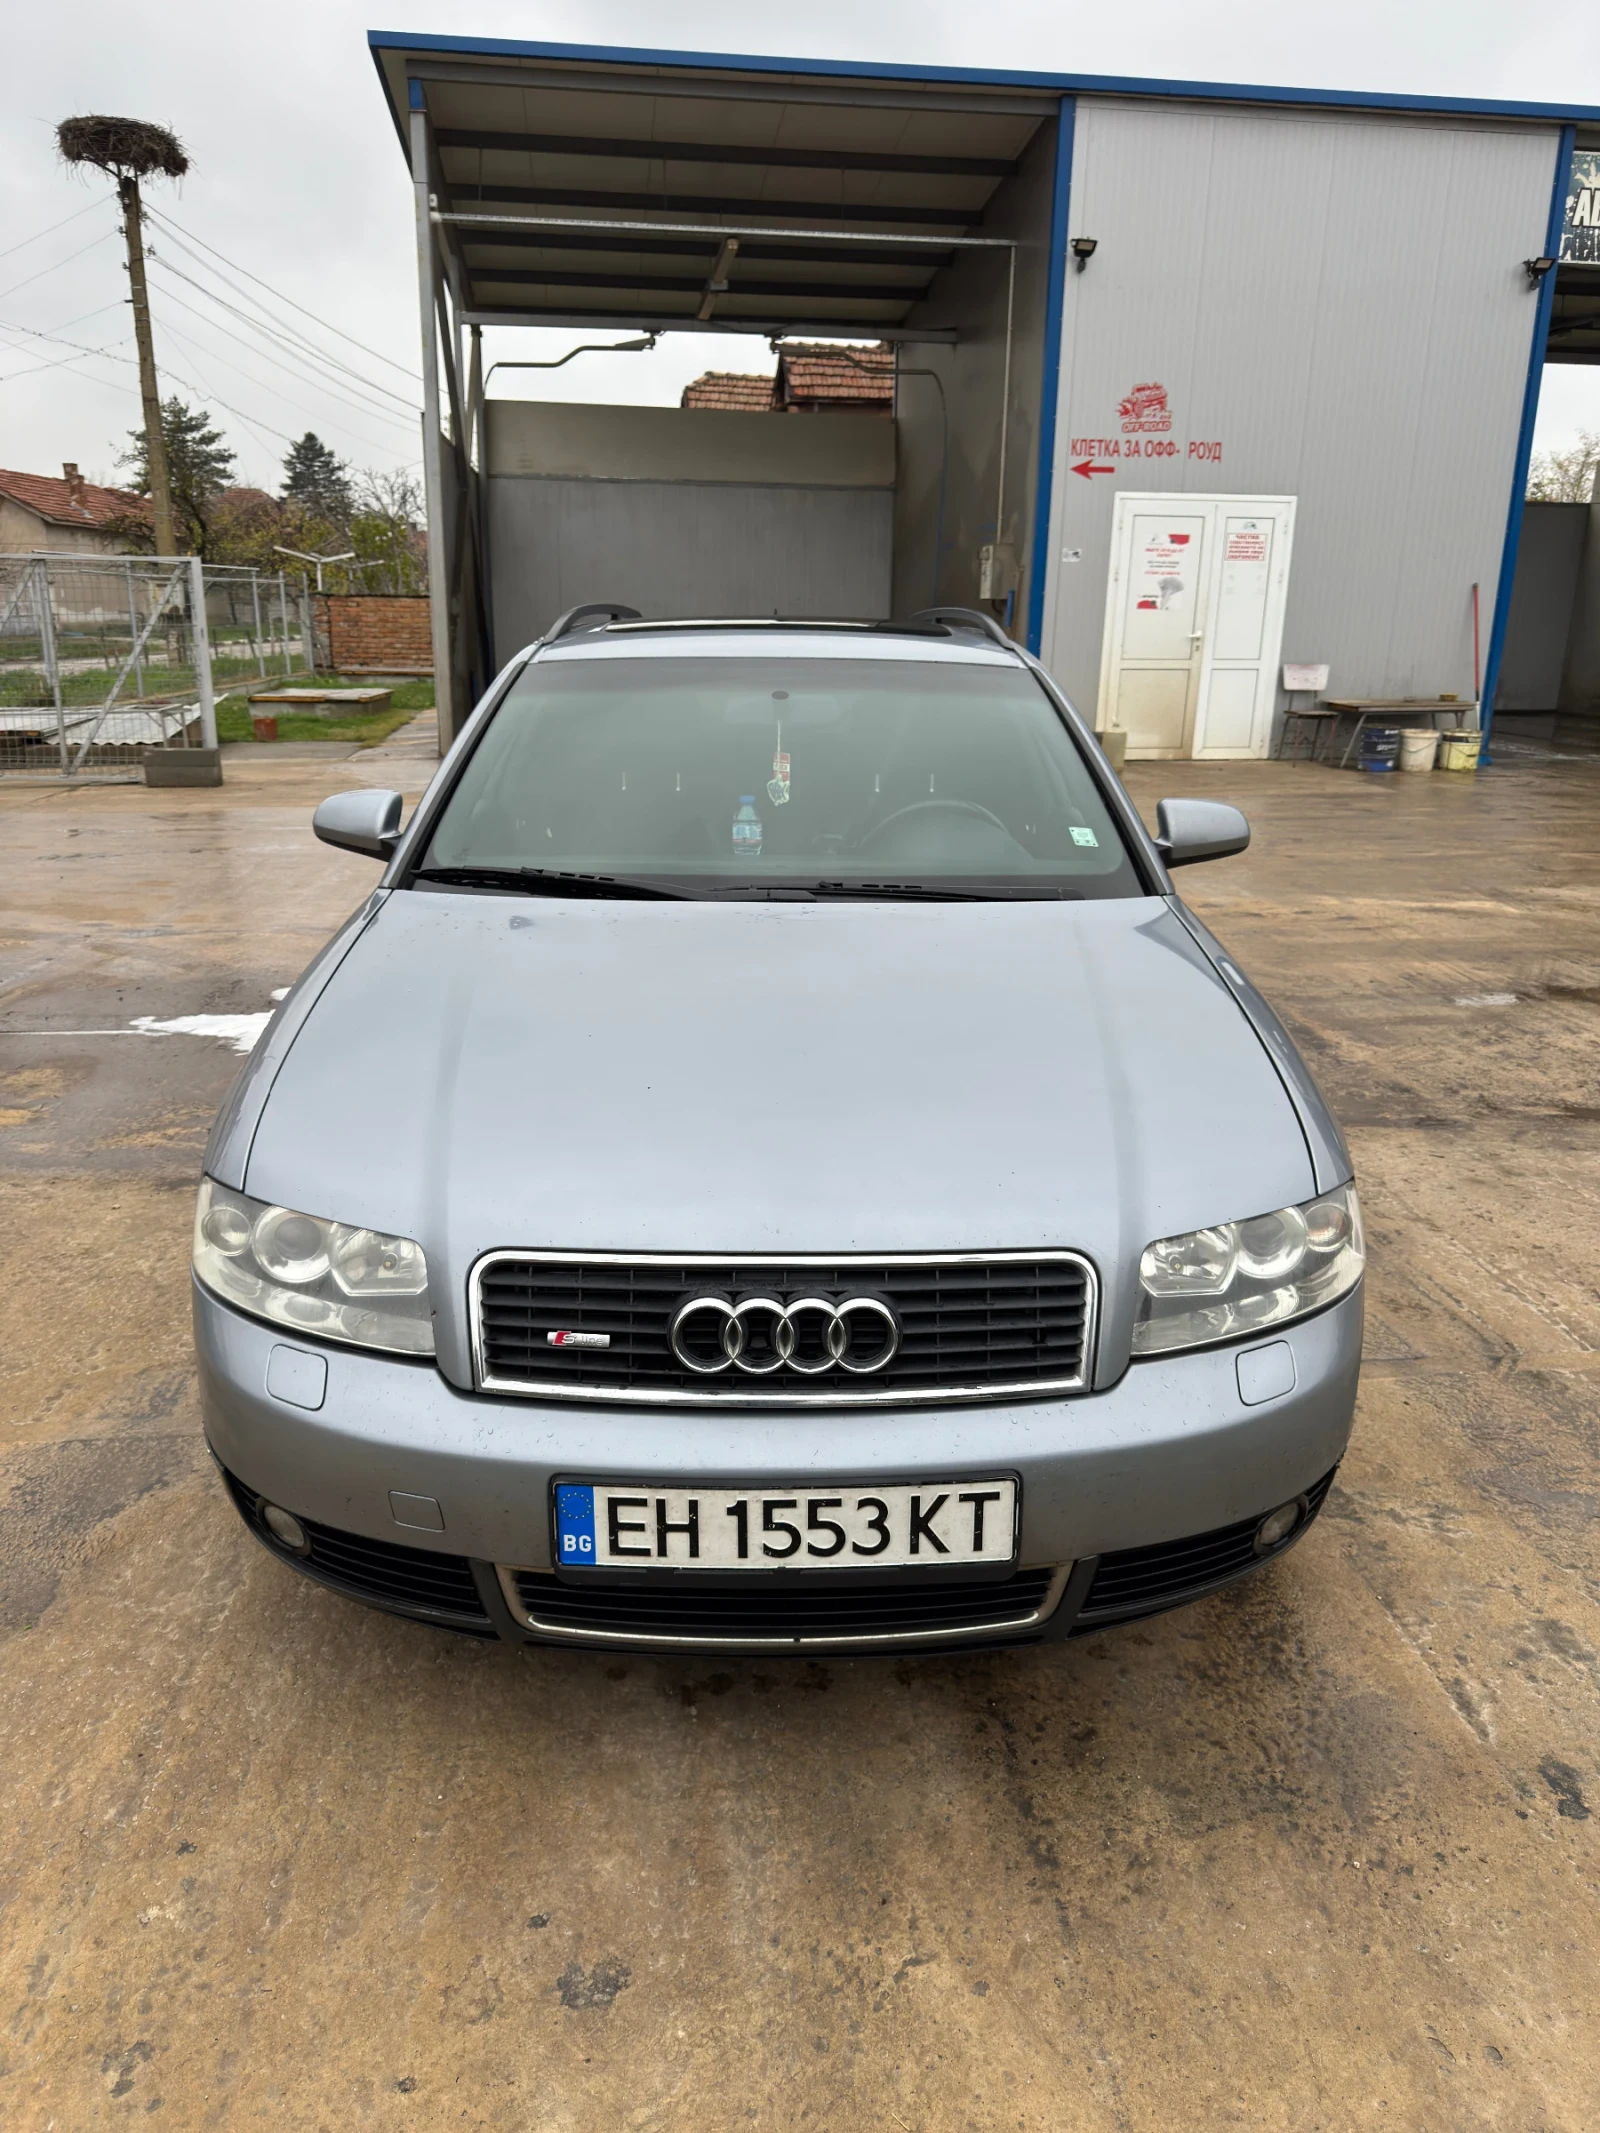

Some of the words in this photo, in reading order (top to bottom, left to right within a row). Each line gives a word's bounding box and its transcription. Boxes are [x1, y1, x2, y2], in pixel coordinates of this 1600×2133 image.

[1122, 421, 1172, 433] OFF-ROAD
[1070, 438, 1121, 457] КЛЕТКА
[1124, 440, 1142, 458] ЗА
[1144, 440, 1181, 458] ОФФ-
[1188, 441, 1223, 463] РОУД
[607, 1496, 700, 1557] EH
[726, 1496, 891, 1558] 1553
[909, 1491, 1001, 1554] KT
[563, 1534, 592, 1553] BG
